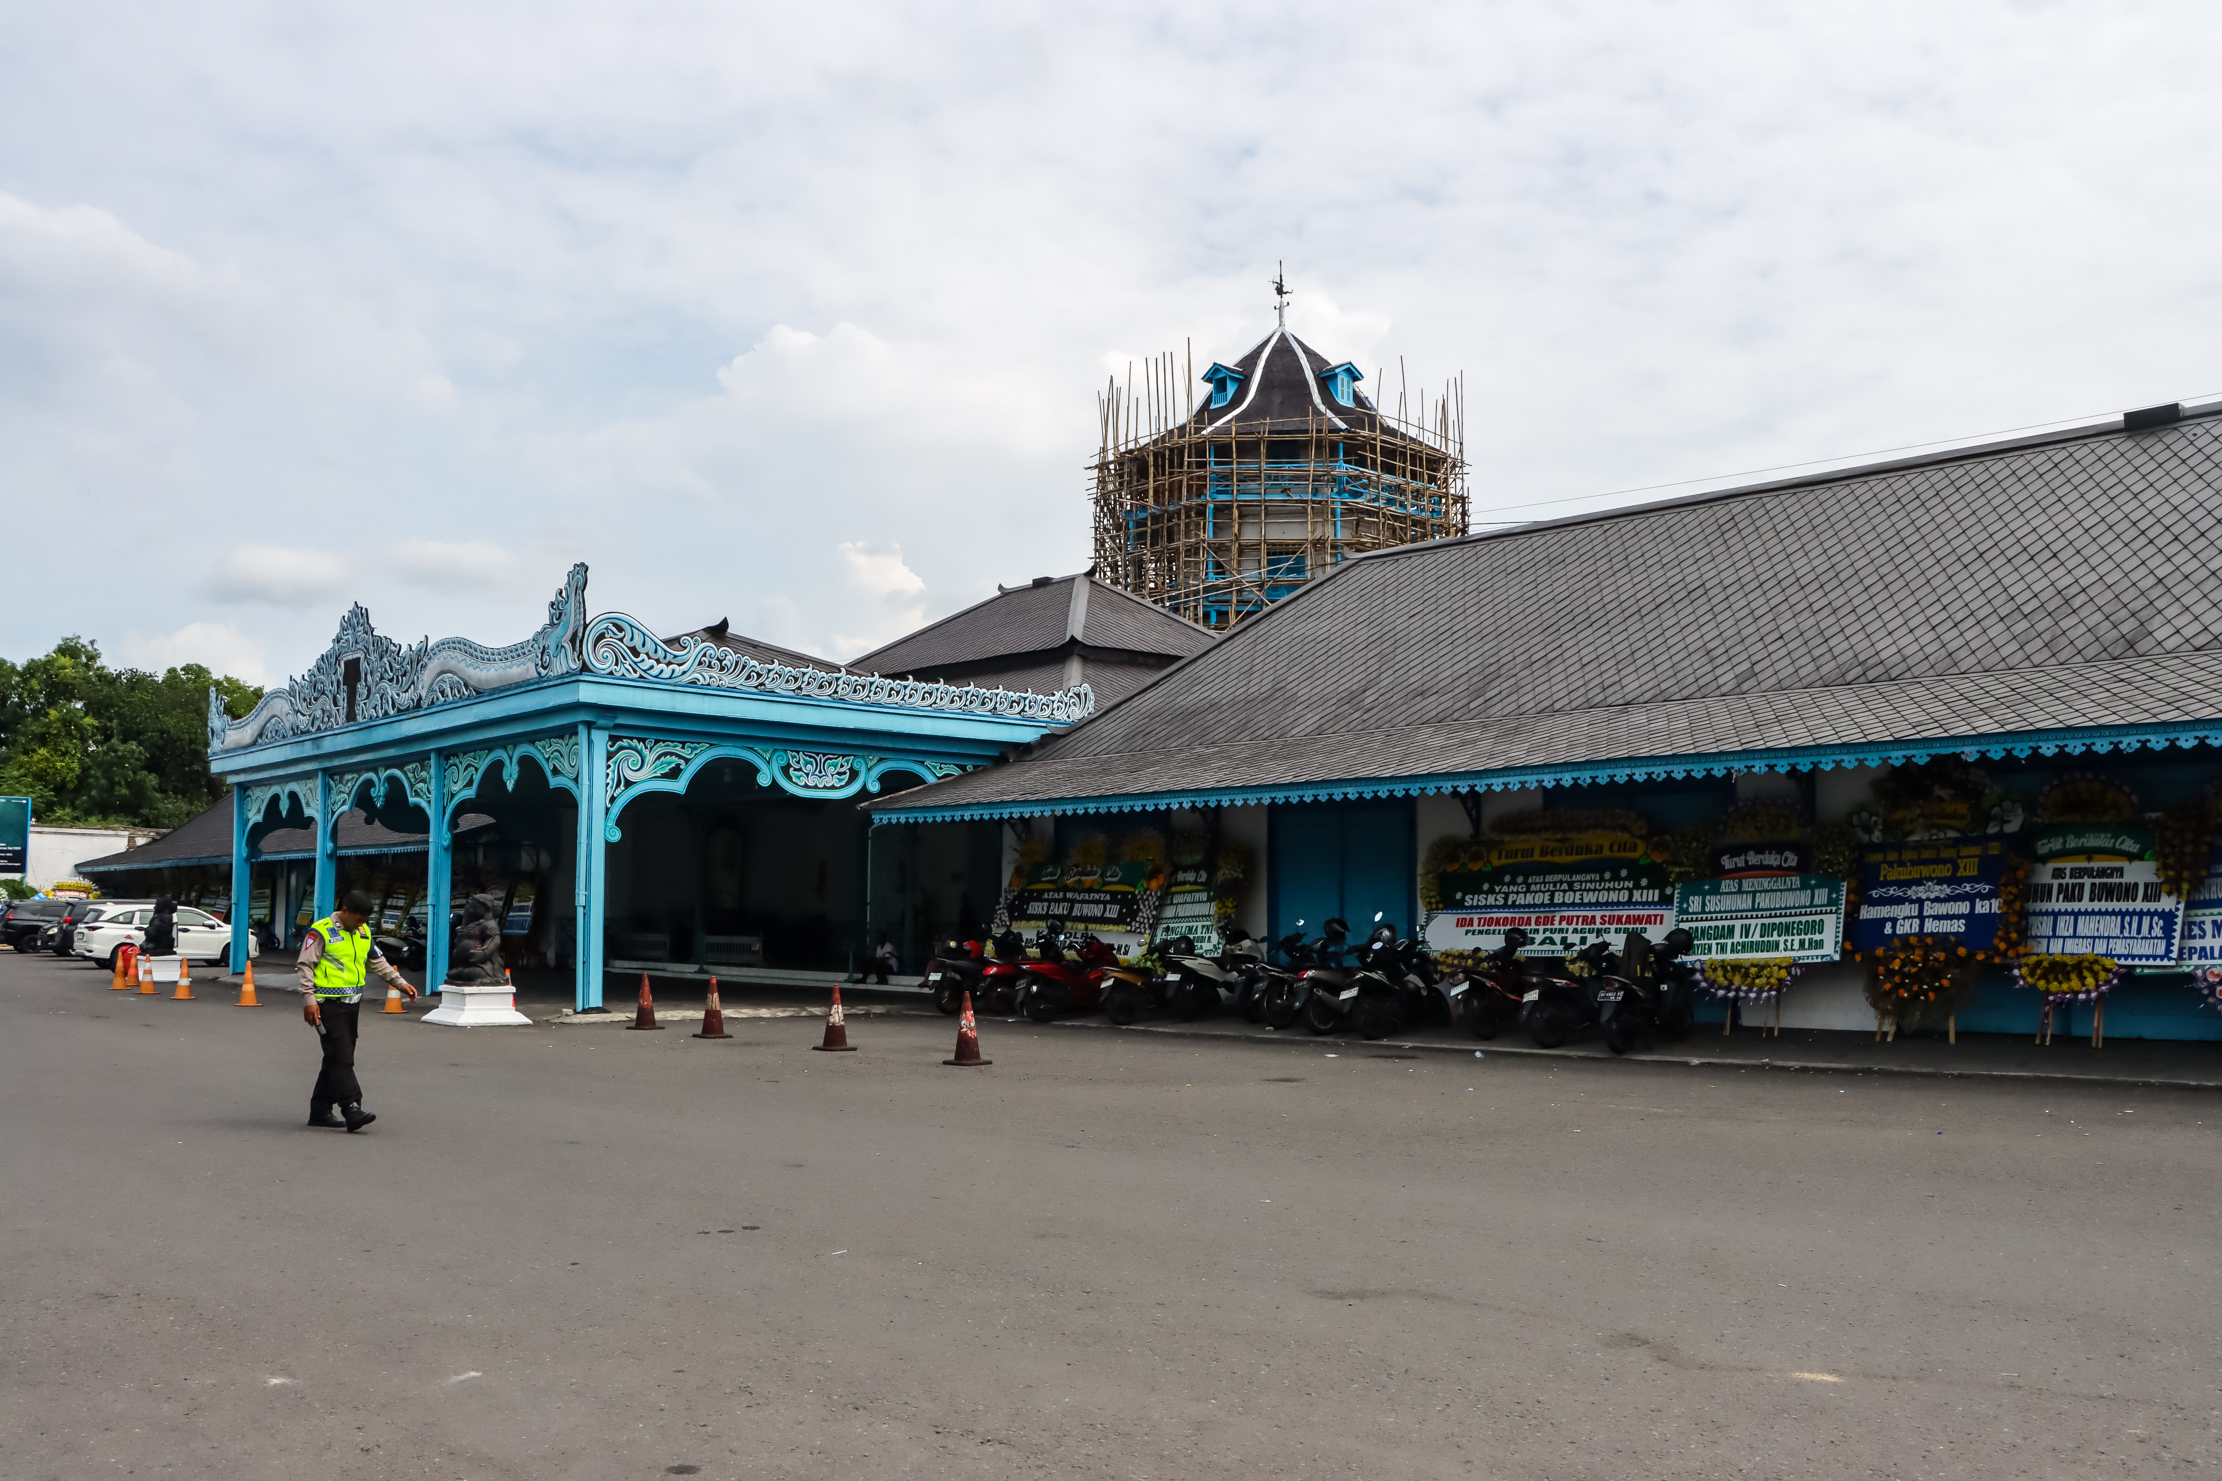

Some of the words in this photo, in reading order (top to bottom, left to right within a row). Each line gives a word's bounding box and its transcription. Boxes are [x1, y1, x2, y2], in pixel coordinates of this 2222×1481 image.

[1497, 846, 1534, 860] Turut
[1540, 841, 1605, 858] Berduka
[1609, 839, 1639, 854] Cita
[2115, 836, 2140, 852] Cita
[1746, 850, 1781, 867] Berduka
[1782, 850, 1798, 867] Cita
[1879, 861, 1953, 880] Pakubuwono
[1956, 857, 1979, 876] XIII
[2051, 867, 2066, 880] ATAS
[2069, 866, 2124, 879] BERPULANGNYA
[1528, 875, 1544, 883] ATAS
[1544, 873, 1600, 882] BERPULANGNYA
[1720, 879, 1739, 892] ATAS
[1742, 876, 1800, 891] MENINGGALNYA
[1494, 884, 1526, 893] YANG
[1529, 882, 1568, 891] MULIA
[1573, 880, 1633, 890] SINUHUN
[2056, 882, 2085, 902] PAKU
[2088, 882, 2139, 902] BUWONO
[2142, 882, 2161, 902] XIII
[1042, 892, 1064, 900] ATAS
[1066, 892, 1111, 901] WAFATNYA
[1464, 894, 1505, 906] SISKS
[1507, 892, 1551, 905] PAKOE
[1554, 890, 1629, 905] BOEWONO
[1632, 889, 1660, 903] XIII
[1688, 895, 1702, 913] SRI
[1705, 893, 1753, 912] SUSUHUNAN
[1755, 890, 1811, 909] PAKUBUWONO
[1813, 888, 1828, 905] XIII
[1027, 902, 1048, 915] SISKS
[1048, 902, 1071, 916] PAKU
[1072, 903, 1103, 918] BUWONO
[1104, 904, 1120, 919] XIII
[1859, 902, 1919, 919] Hamengku
[1923, 899, 1970, 916] Bawono
[1455, 916, 1473, 928] IDA
[1476, 915, 1533, 927] TJOKORDA
[1534, 915, 1559, 927] GDE
[1560, 914, 1597, 926] PUTRA
[1599, 914, 1664, 926] SUKAWATI
[1884, 921, 1893, 935] &
[1896, 919, 1920, 934] GKR
[1923, 917, 1966, 933] Hemas
[2056, 915, 2075, 936] IHZA
[1542, 927, 1570, 935] PURI
[1573, 926, 1611, 935] AGUNG
[2180, 920, 2206, 940] ES
[1527, 936, 1588, 946] BALI
[1691, 942, 1712, 955] AYJEN
[1715, 942, 1728, 954] TNI
[2179, 946, 2222, 961] EPAL
